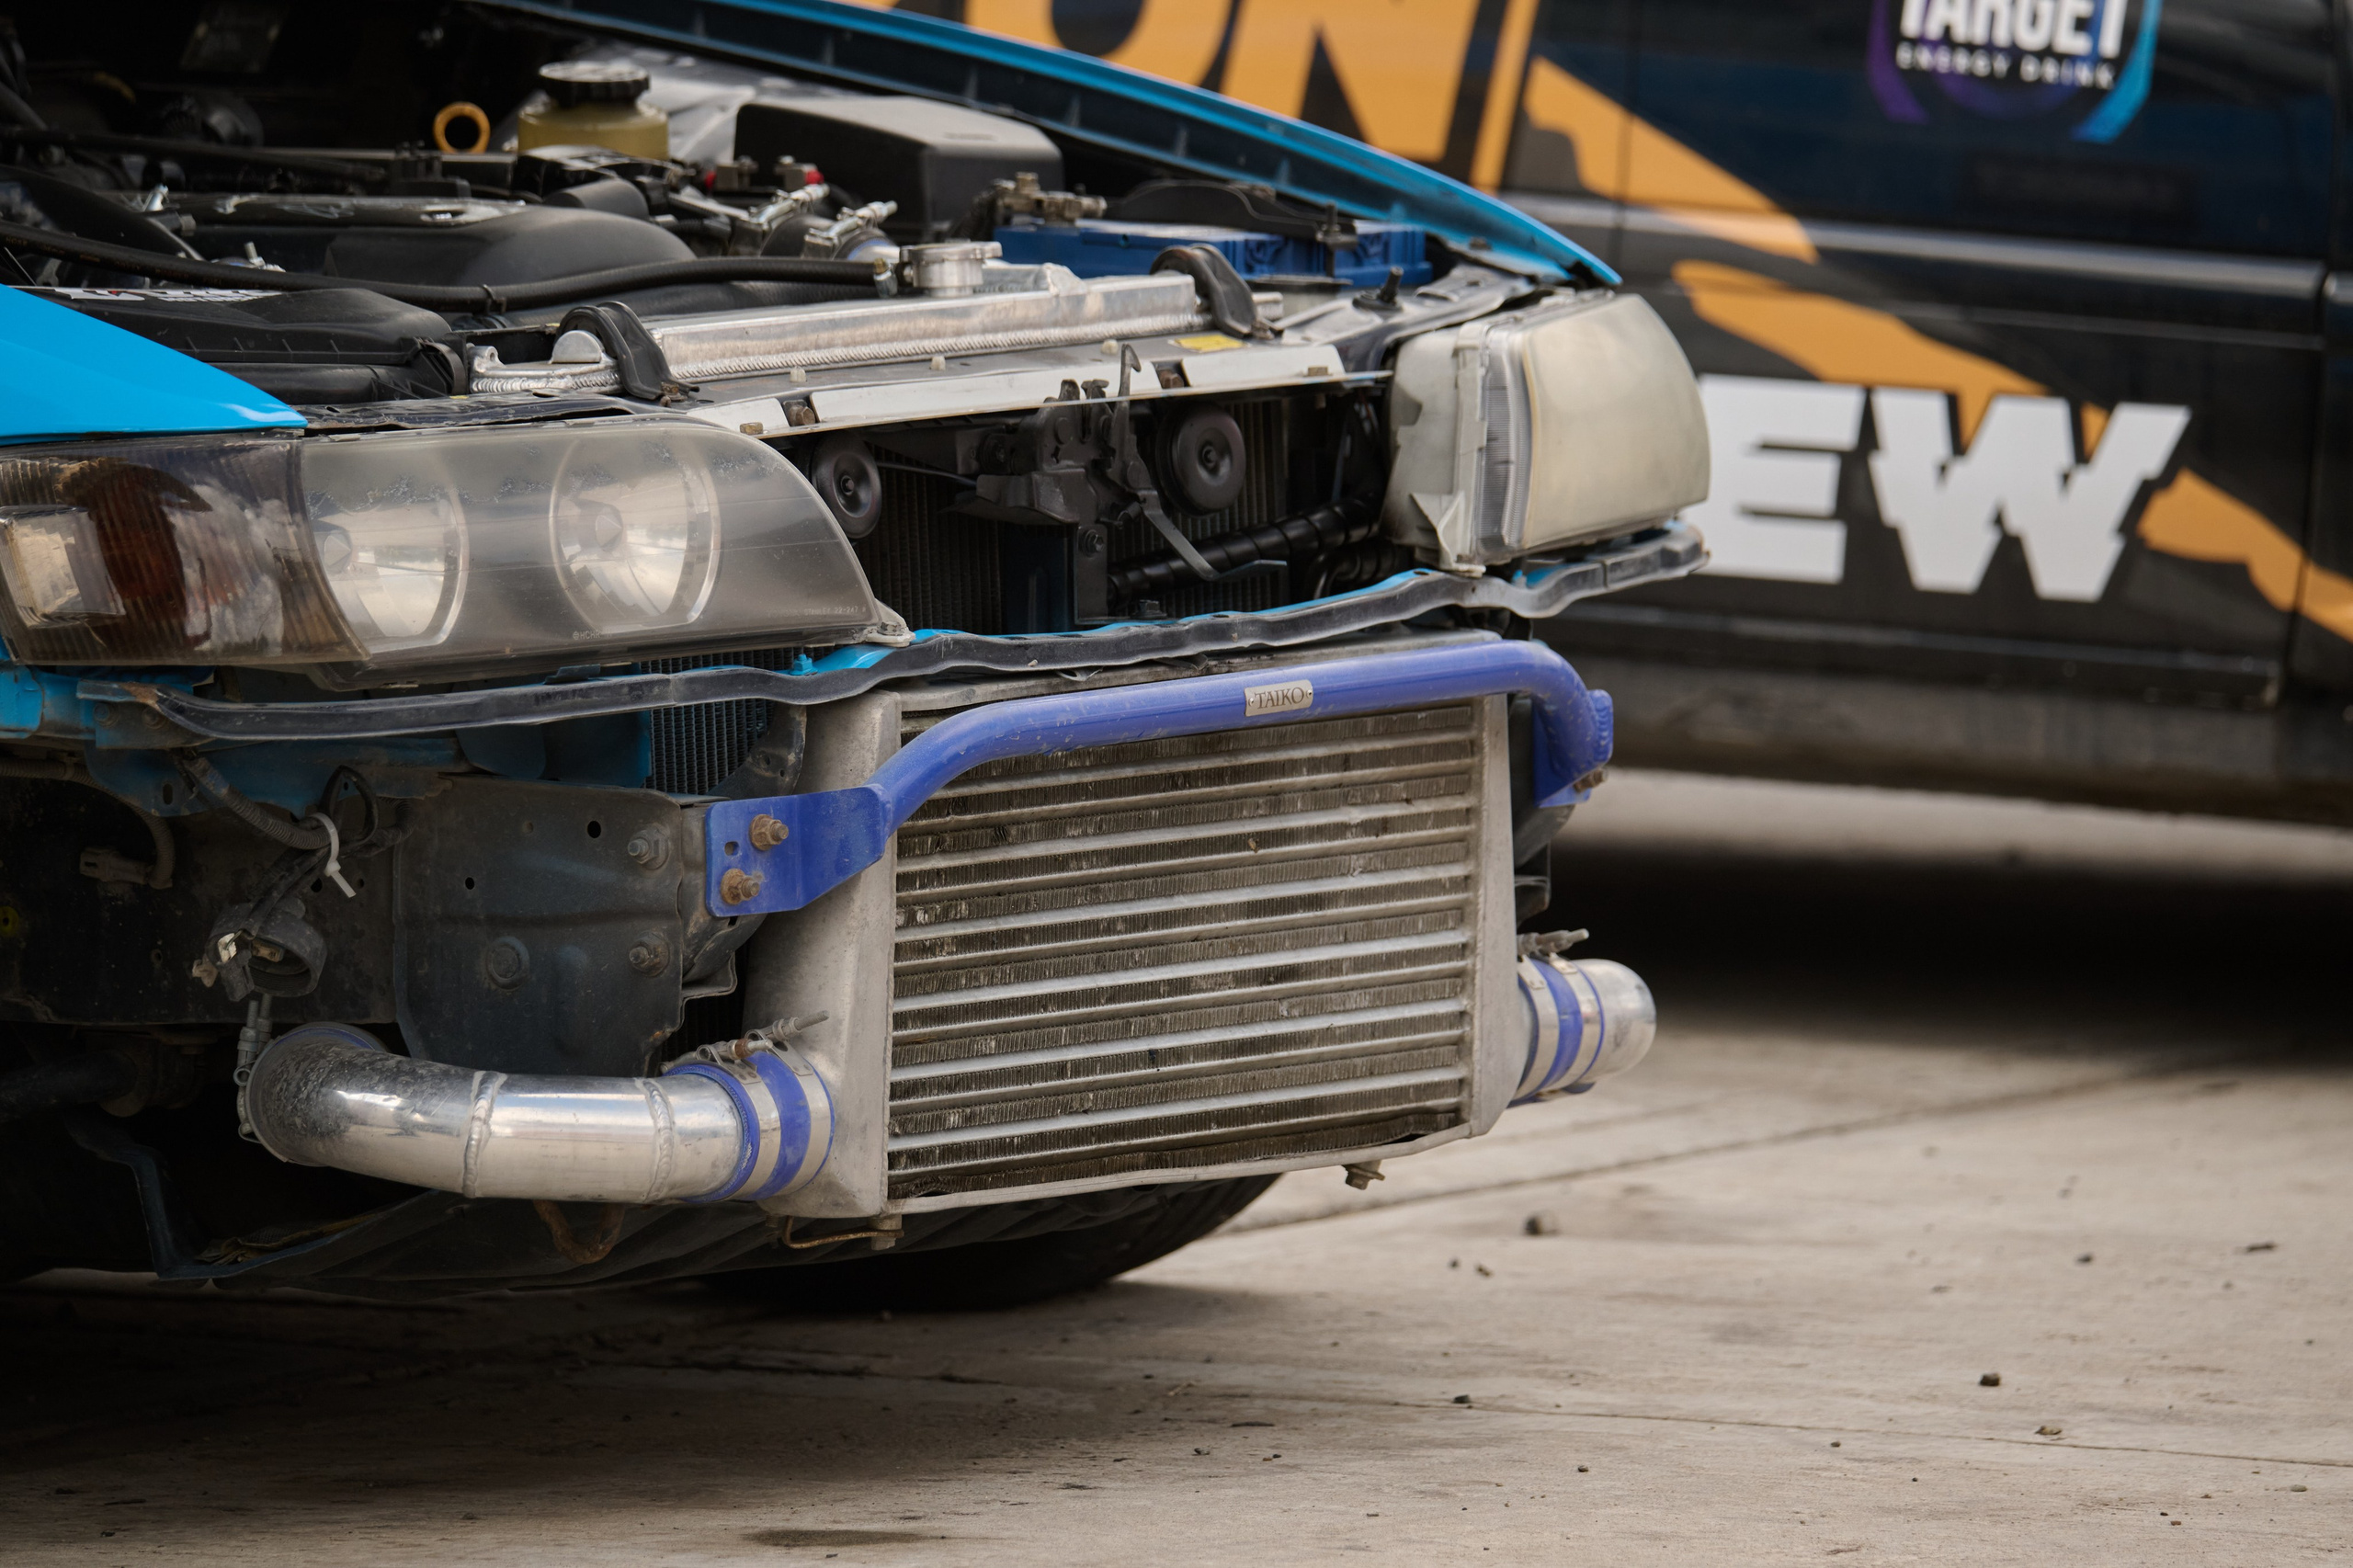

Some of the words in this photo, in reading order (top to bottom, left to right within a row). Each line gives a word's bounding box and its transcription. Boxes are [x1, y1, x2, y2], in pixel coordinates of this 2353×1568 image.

[1895, 40, 2011, 79] ENERGY
[2019, 53, 2115, 90] DRINK
[1254, 687, 1304, 709] TAIKO
